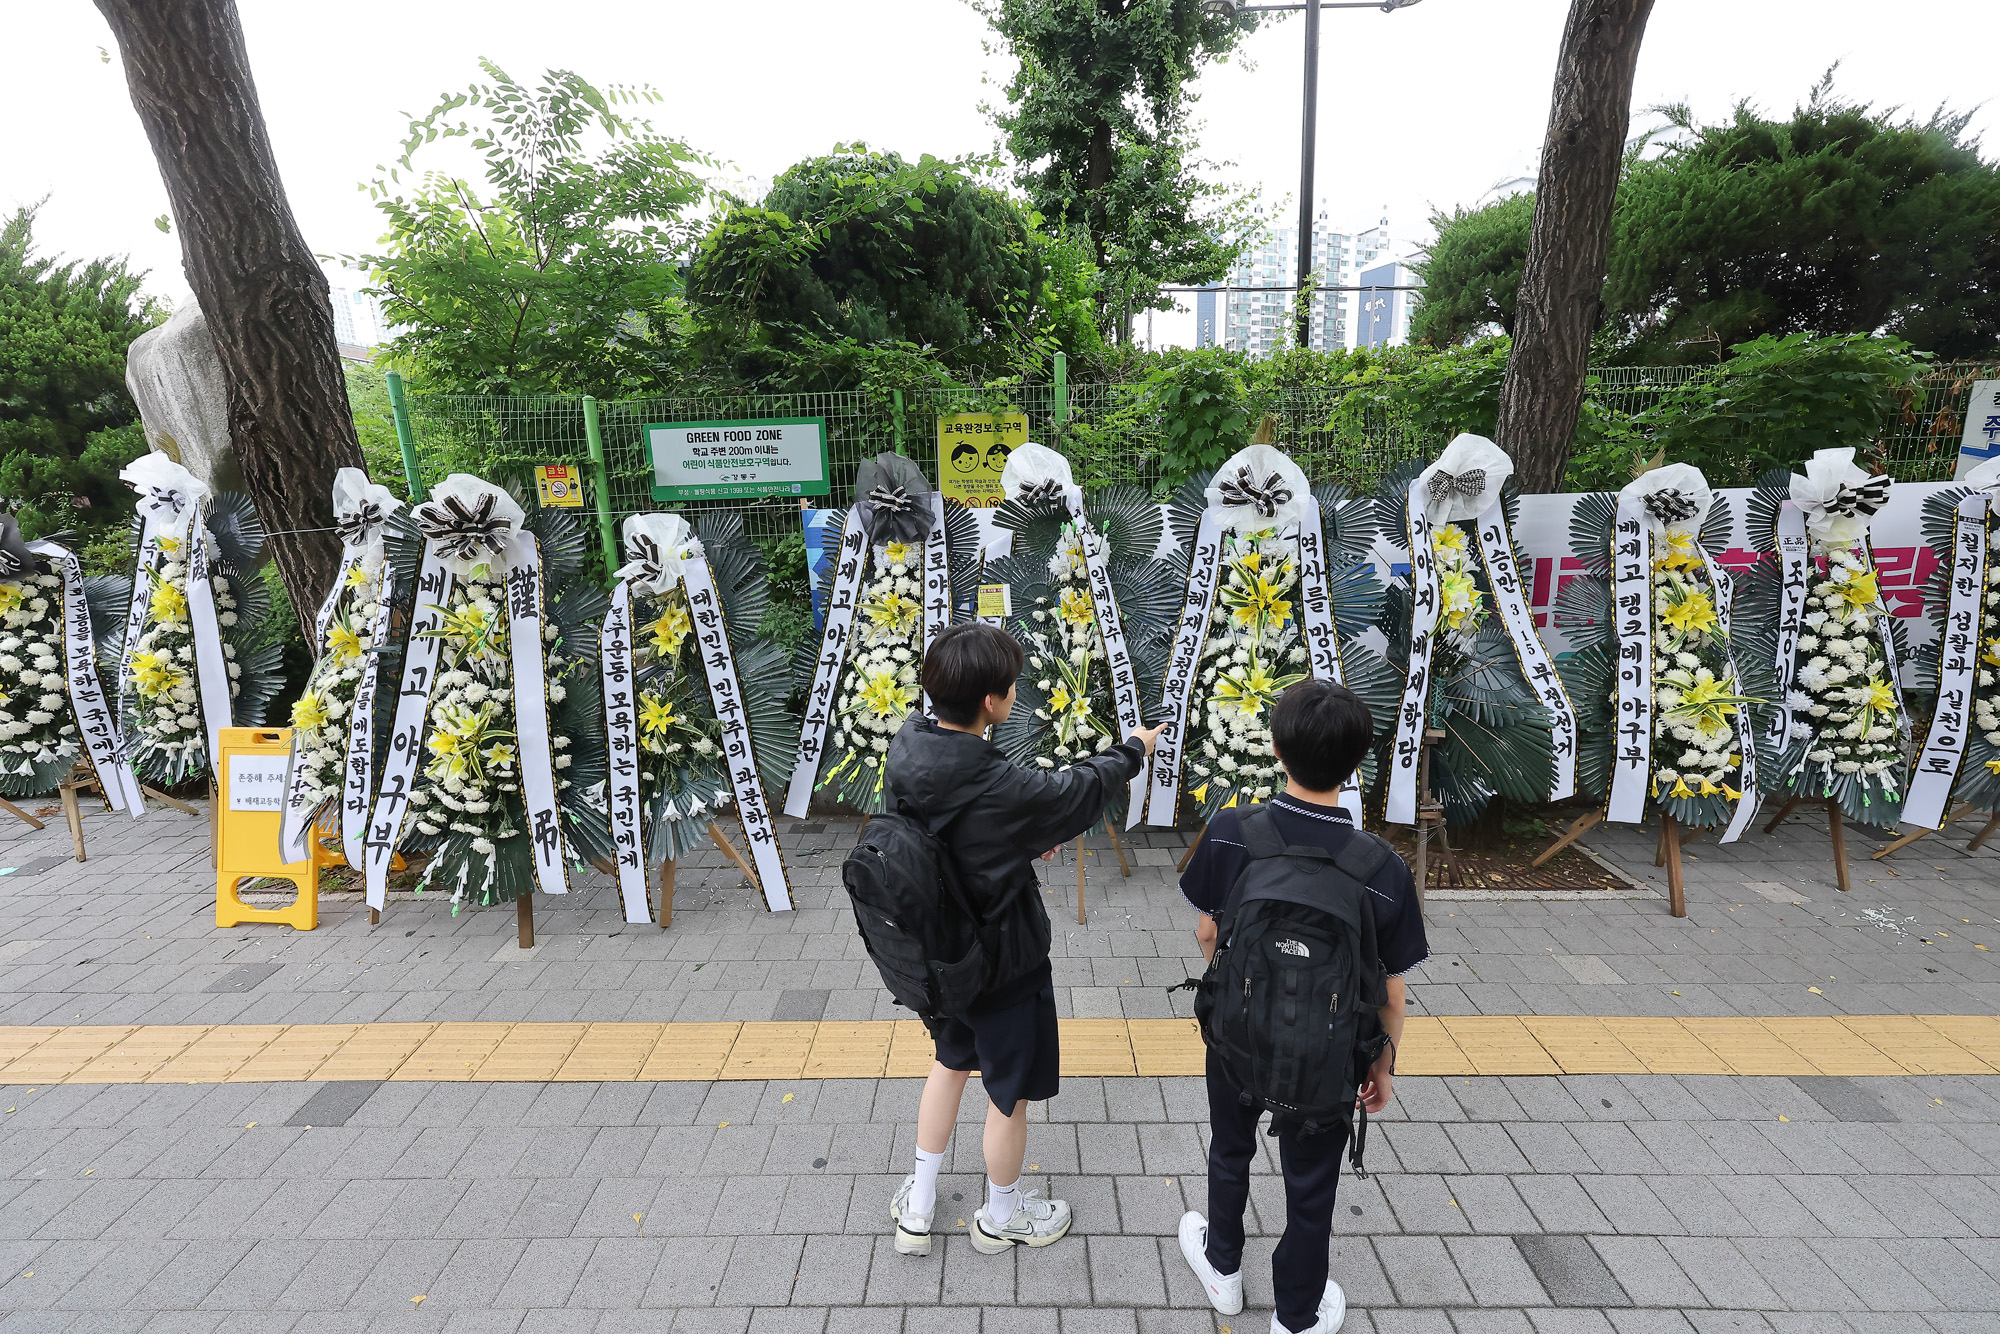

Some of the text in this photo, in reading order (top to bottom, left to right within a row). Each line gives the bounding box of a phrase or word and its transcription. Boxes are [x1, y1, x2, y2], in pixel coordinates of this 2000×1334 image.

[547, 467, 566, 475] 금연
[682, 457, 792, 470] 어린이 식품안전보호구역입니다.
[686, 429, 782, 444] GREEN FOOD ZONE
[692, 445, 779, 457] 학교 주변 200m 이내는
[717, 487, 729, 495] 신고
[743, 486, 756, 494] 또는
[1955, 532, 1979, 597] 철저한
[799, 529, 863, 763] 배재고 야구선수단
[1091, 565, 1121, 644] 일베선수
[1112, 651, 1138, 729] 프로지명
[1301, 533, 1343, 684] 역사를 망각
[1399, 513, 1434, 769] 가야지 배재학당
[1483, 524, 1518, 594] 이승만
[1531, 663, 1577, 758] 부정선거
[1616, 516, 1647, 768] 배재고 탱크데이 야구부
[1944, 610, 1974, 677] 성찰과
[71, 647, 100, 702] 모욕하는
[366, 565, 447, 866] 배재고 야구부
[508, 564, 559, 868] 謹 弔
[607, 690, 640, 779] 모욕하는
[690, 590, 775, 845] 대한민국 민주주의 과분하다
[1919, 688, 1964, 777] 실천으로
[238, 773, 287, 783] 존중해 주세
[245, 796, 283, 806] 배재고등학
[346, 717, 370, 815] 애도합니다
[614, 786, 643, 870] 국민에게
[1275, 941, 1298, 949] NORTH
[1281, 947, 1298, 955] FACE
